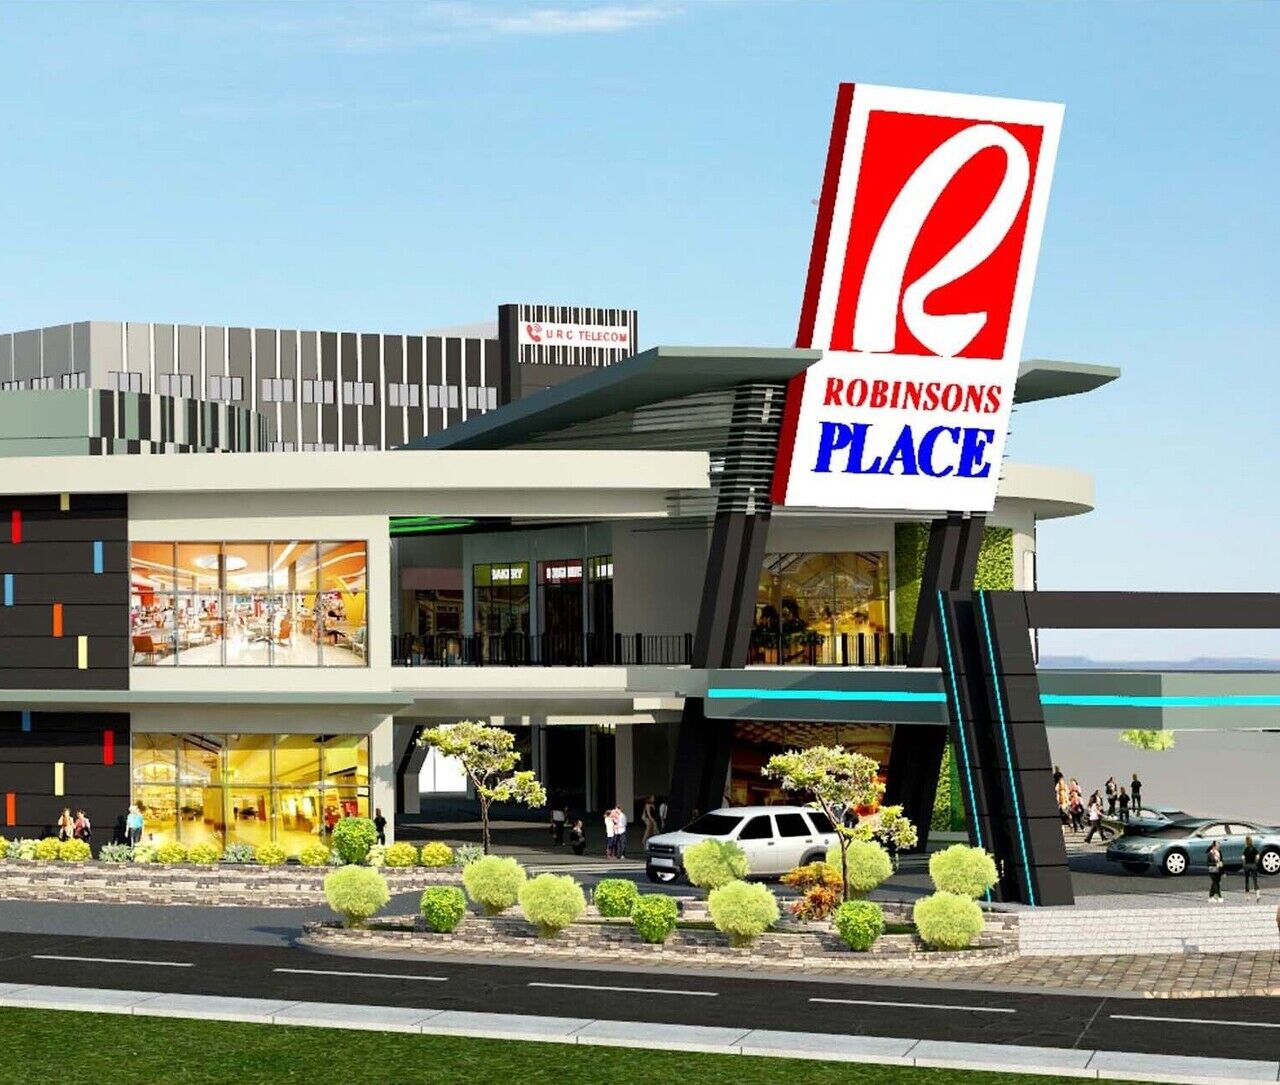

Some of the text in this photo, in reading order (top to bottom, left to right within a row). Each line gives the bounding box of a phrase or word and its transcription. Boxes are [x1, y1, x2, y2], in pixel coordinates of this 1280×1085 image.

[579, 330, 627, 342] TELECOM
[823, 377, 1002, 415] ROBINSONS
[810, 421, 996, 479] PLACE
